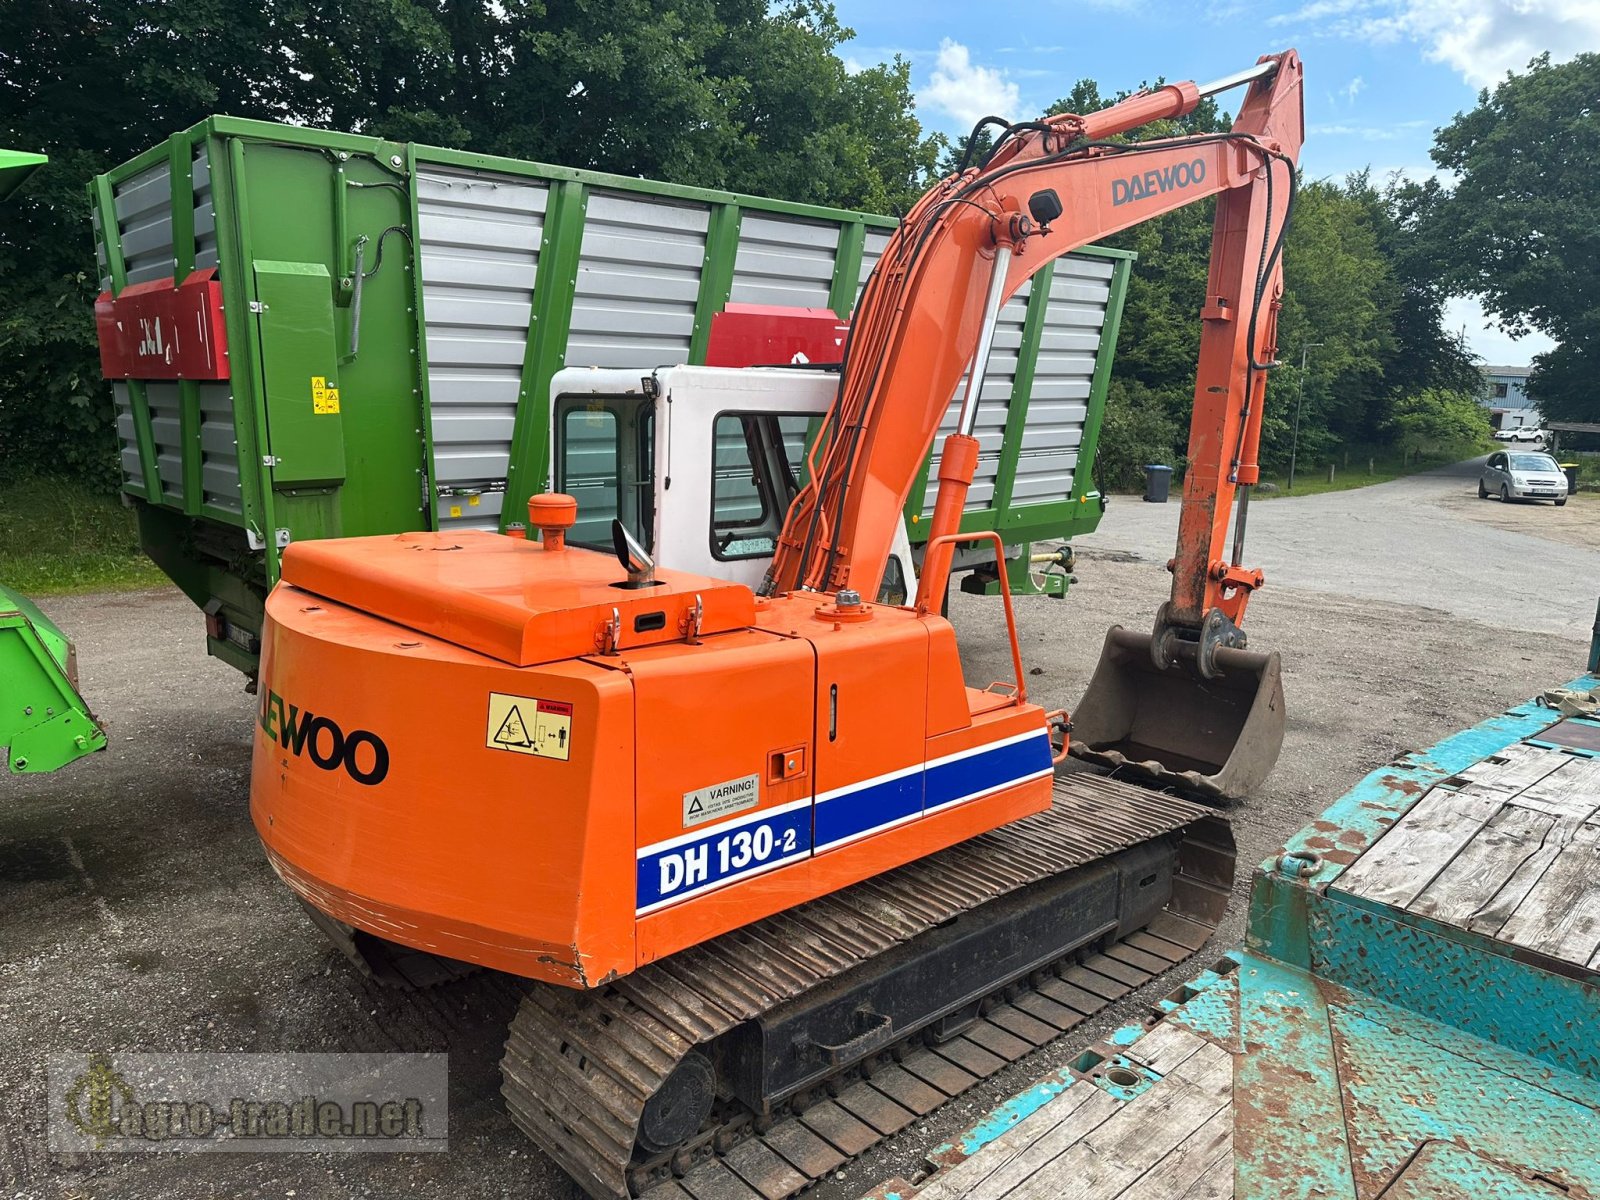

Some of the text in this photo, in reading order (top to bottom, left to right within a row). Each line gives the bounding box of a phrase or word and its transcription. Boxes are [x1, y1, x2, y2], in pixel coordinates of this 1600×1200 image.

[1112, 158, 1206, 207] DAEWOO
[710, 780, 755, 800] VARNING!
[659, 824, 796, 895] DH 130-2
